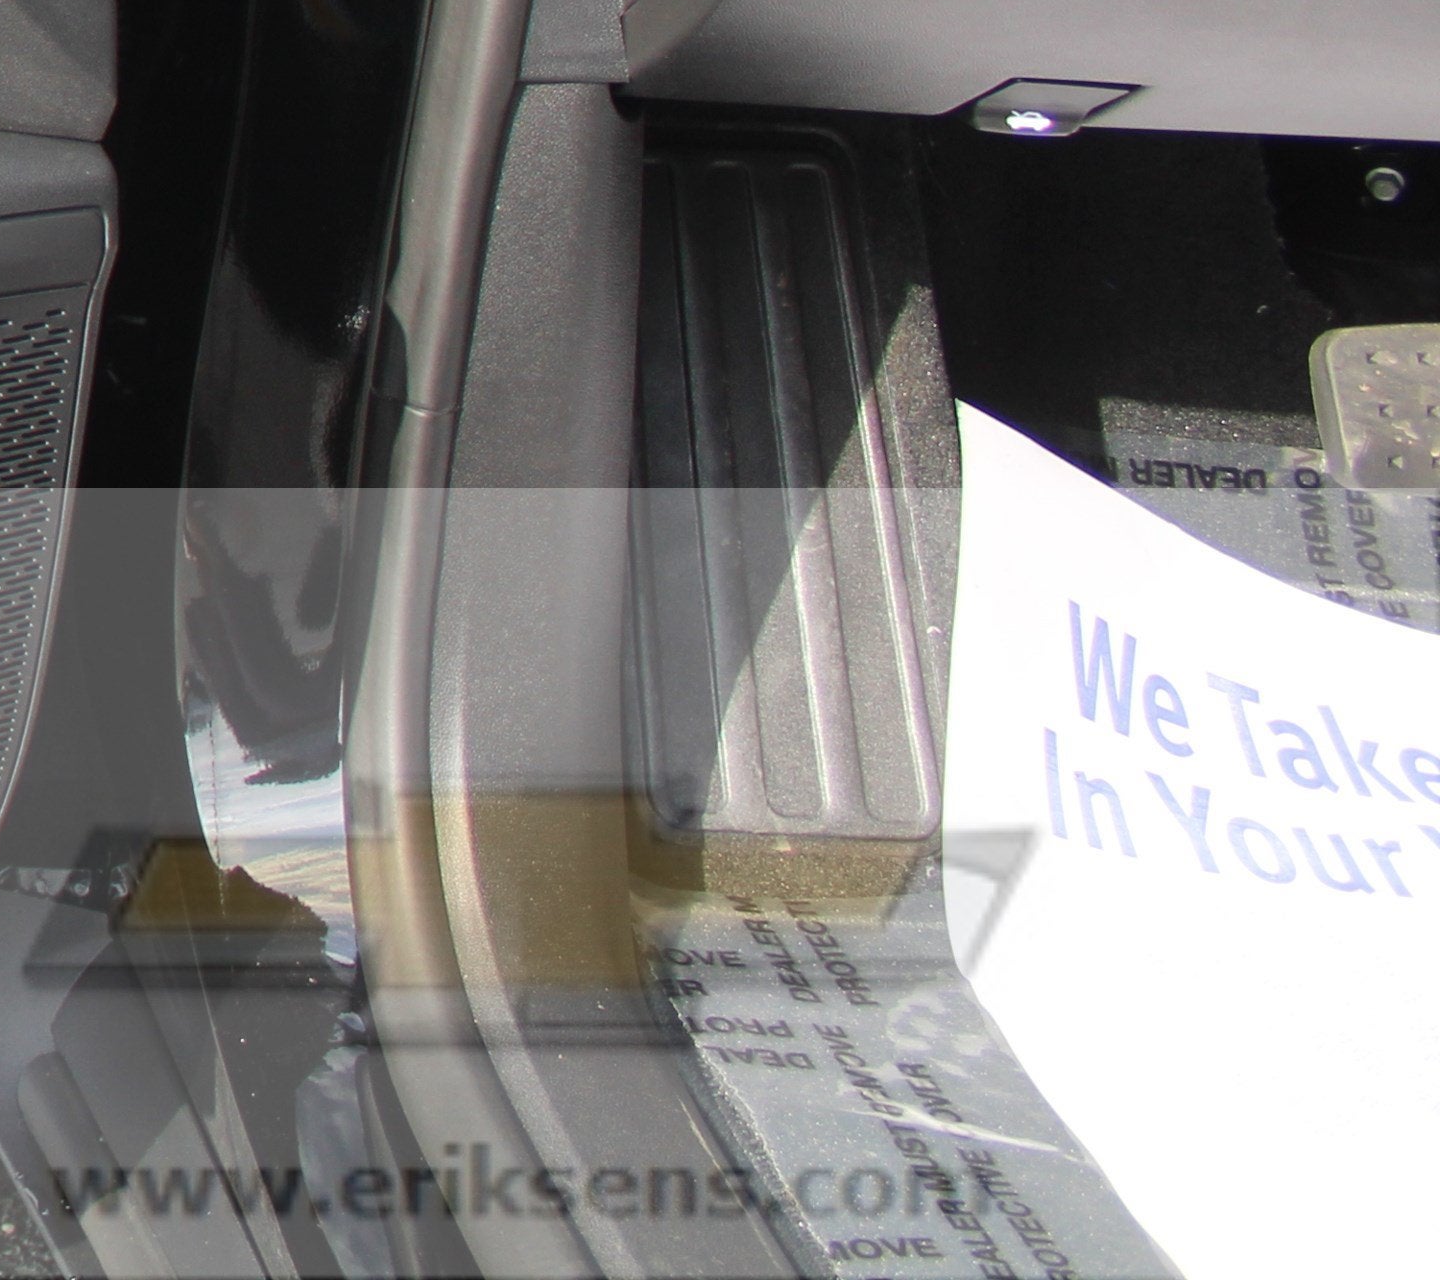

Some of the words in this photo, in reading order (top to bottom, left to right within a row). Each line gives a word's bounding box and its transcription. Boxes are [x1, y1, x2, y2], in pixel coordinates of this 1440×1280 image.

[1130, 458, 1268, 494] DEALER
[1068, 599, 1194, 757] We
[1206, 671, 1440, 804] Take
[1044, 726, 1138, 858] In
[1144, 770, 1414, 898] Your
[743, 918, 822, 1004] DEALER
[702, 1045, 817, 1070] DEAL
